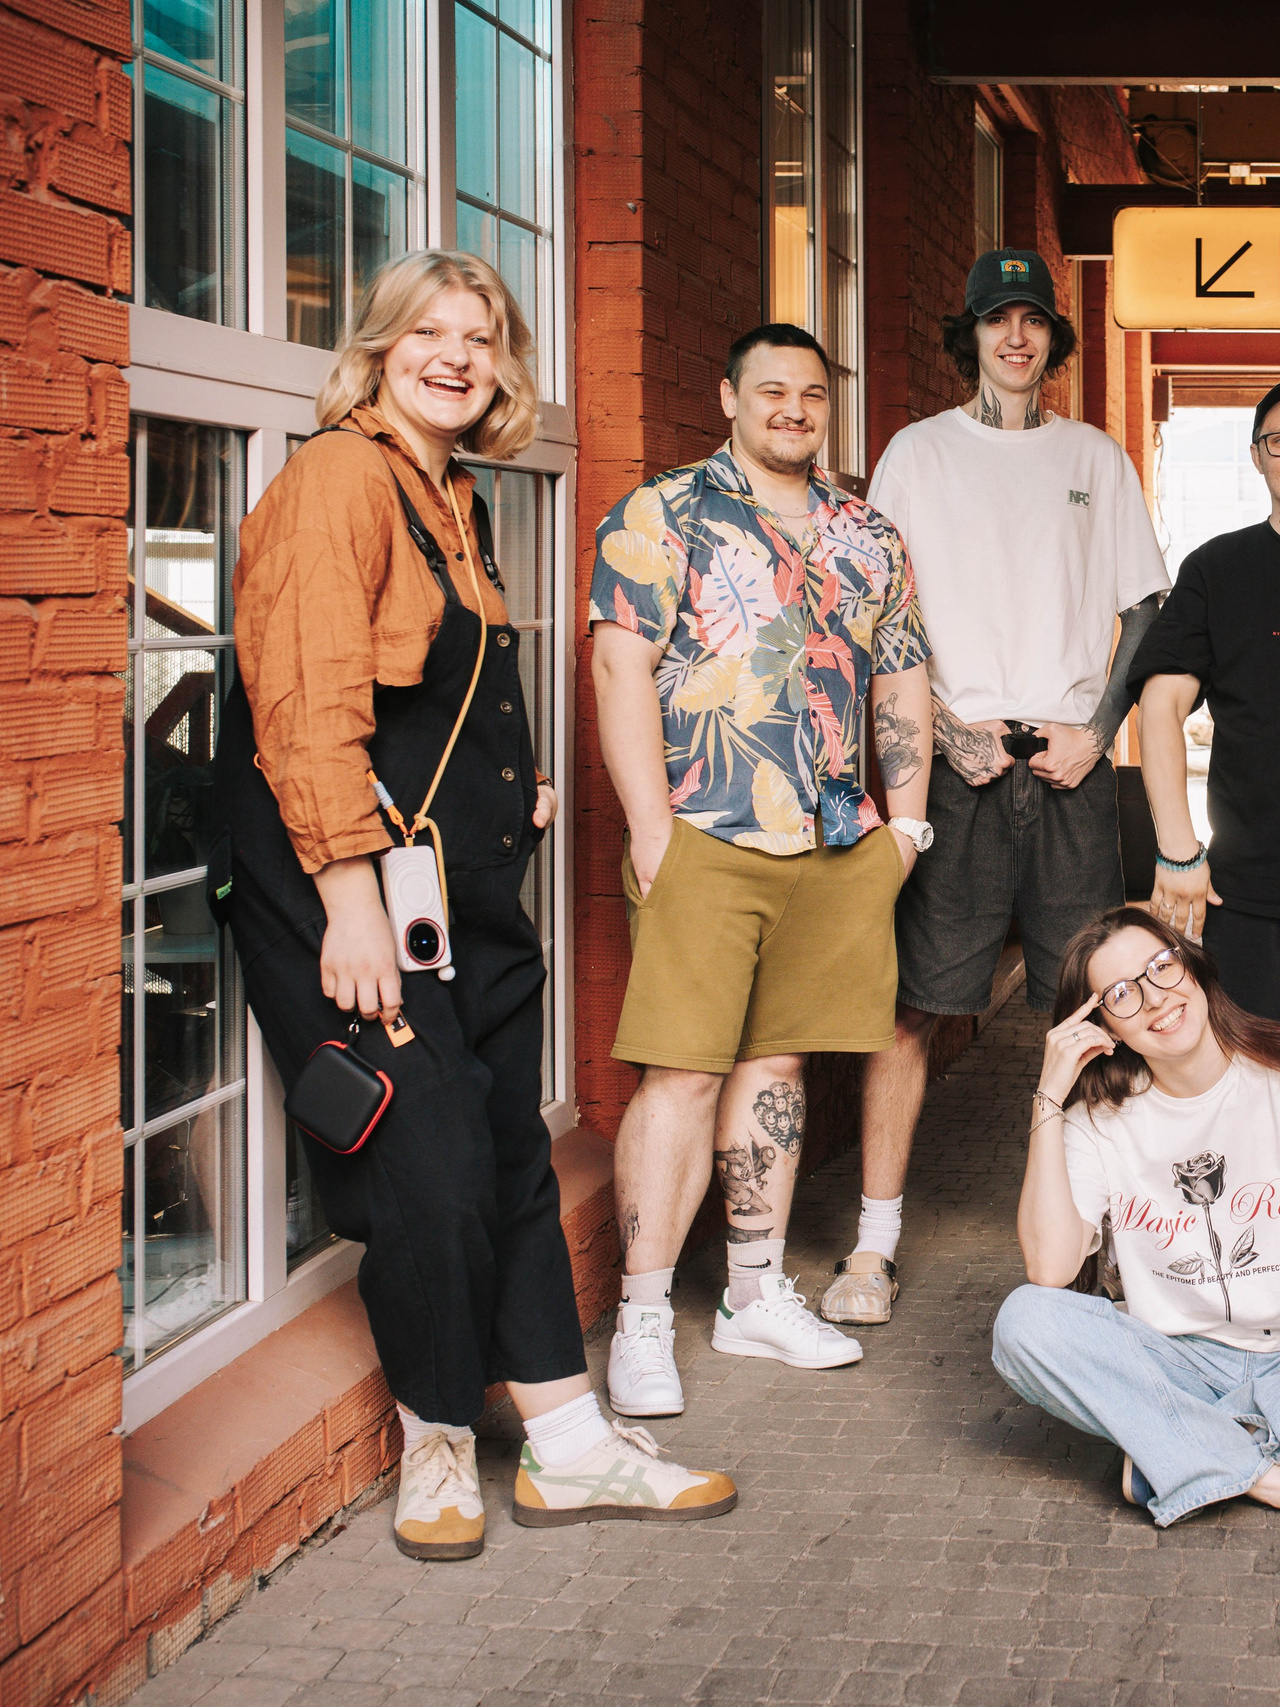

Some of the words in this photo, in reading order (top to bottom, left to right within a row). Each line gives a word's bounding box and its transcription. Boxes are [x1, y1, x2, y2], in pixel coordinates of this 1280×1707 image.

[1109, 1191, 1199, 1251] Magic
[1151, 1269, 1165, 1278] THE
[1166, 1274, 1197, 1286] EPITOME
[1198, 1277, 1206, 1285] OF
[1207, 1271, 1234, 1284] BEAUTY
[1235, 1269, 1251, 1278] AND
